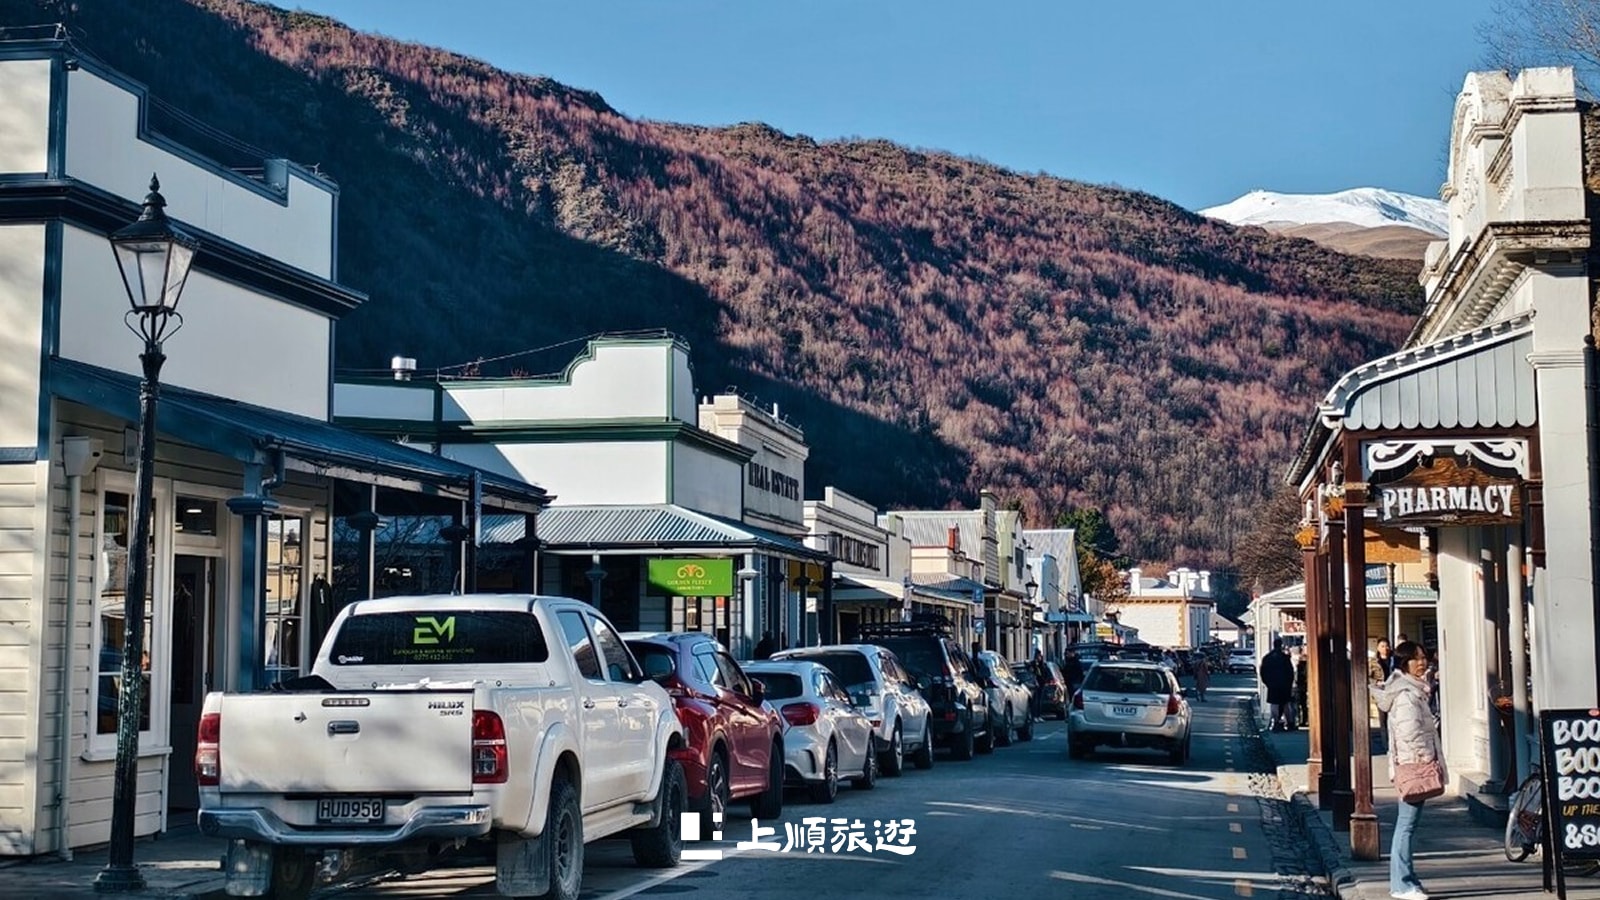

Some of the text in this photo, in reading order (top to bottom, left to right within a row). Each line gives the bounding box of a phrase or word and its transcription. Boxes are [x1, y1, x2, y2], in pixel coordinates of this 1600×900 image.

[748, 461, 800, 502] REAL ESTATE
[1381, 484, 1514, 521] PHARMACY
[428, 701, 465, 709] HILUX
[320, 801, 381, 817] HUD950
[1562, 805, 1578, 816] UP
